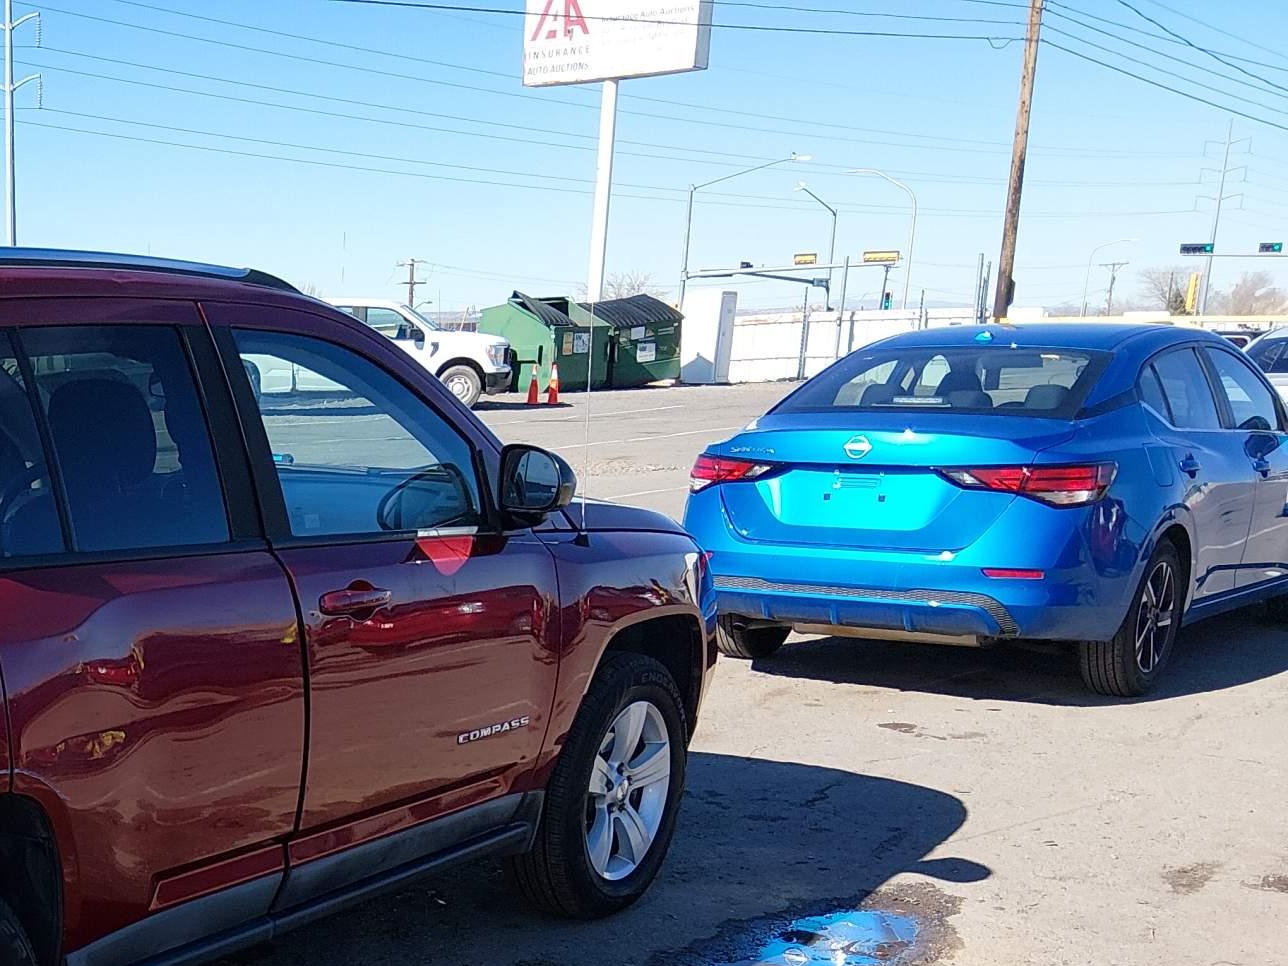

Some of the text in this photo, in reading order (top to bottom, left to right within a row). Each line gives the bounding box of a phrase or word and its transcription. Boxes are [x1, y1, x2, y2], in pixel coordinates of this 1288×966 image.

[527, 45, 590, 61] INSURANCE
[527, 65, 549, 76] AUTO
[458, 715, 530, 744] COMPASS
